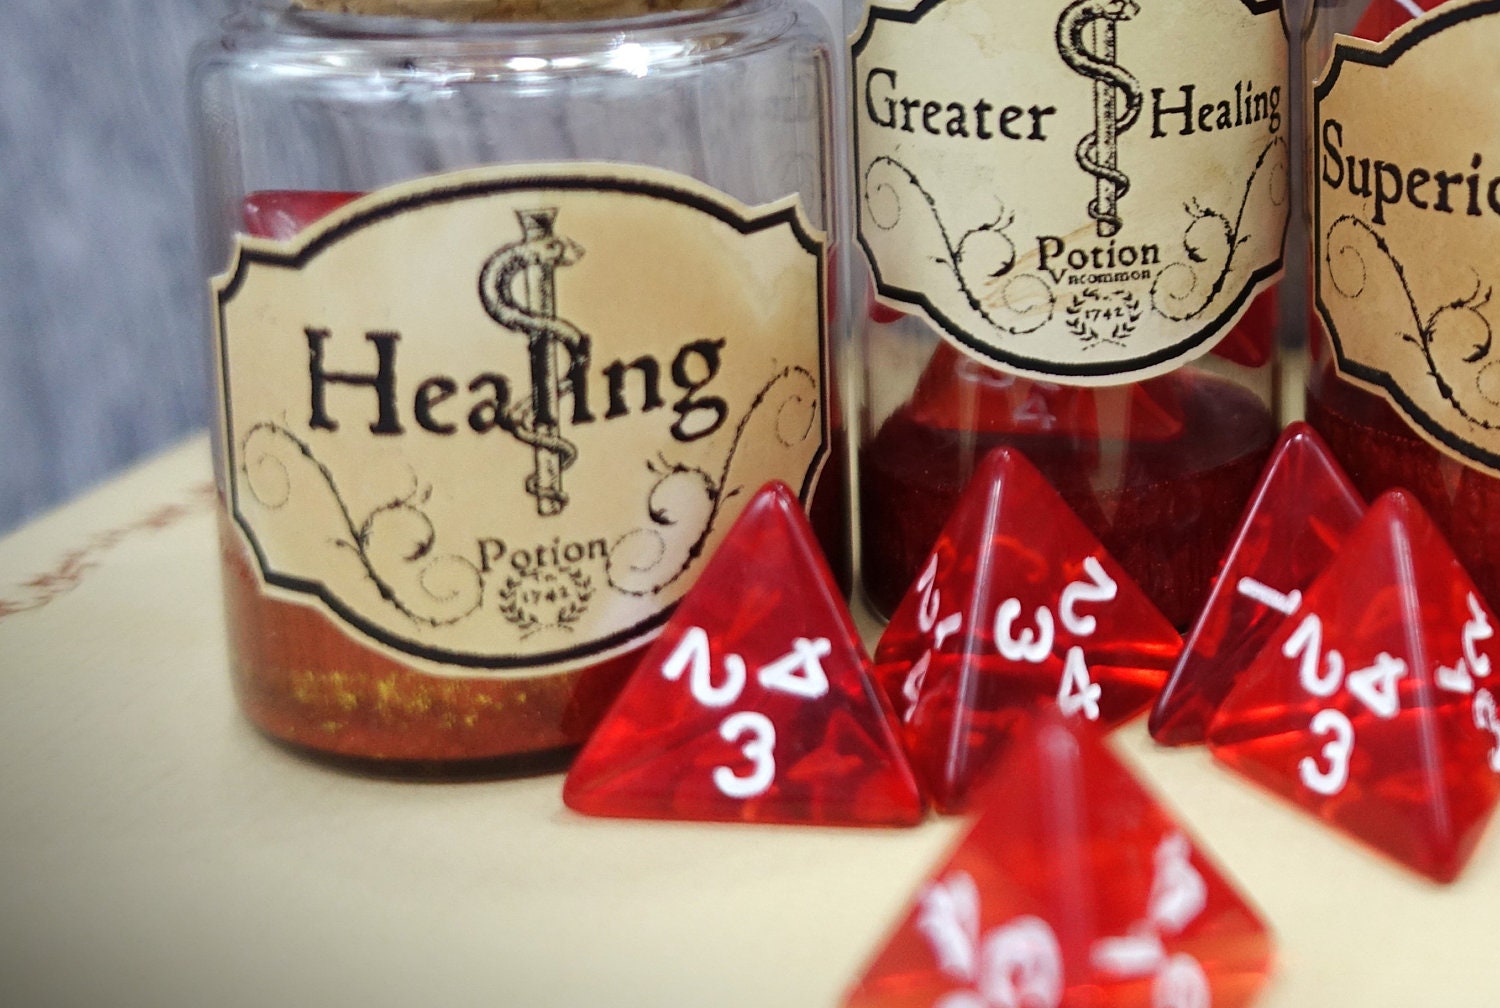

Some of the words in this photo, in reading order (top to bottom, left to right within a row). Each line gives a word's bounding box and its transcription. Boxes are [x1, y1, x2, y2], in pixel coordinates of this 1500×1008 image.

[865, 67, 1058, 142] Greater
[1150, 79, 1282, 139] Healing
[1036, 236, 1161, 270] Potion
[1085, 307, 1125, 322] 1742
[303, 326, 728, 442] Healing
[477, 535, 607, 572] Potion
[994, 598, 1055, 663] 3
[1059, 556, 1118, 636] 2
[1237, 577, 1302, 615] 1
[661, 626, 747, 708] 2
[757, 637, 831, 699] 4
[1057, 646, 1102, 720] 4
[1283, 613, 1344, 697] 2
[1346, 652, 1406, 718] 4
[713, 711, 776, 798] 3
[1300, 709, 1354, 795] 3
